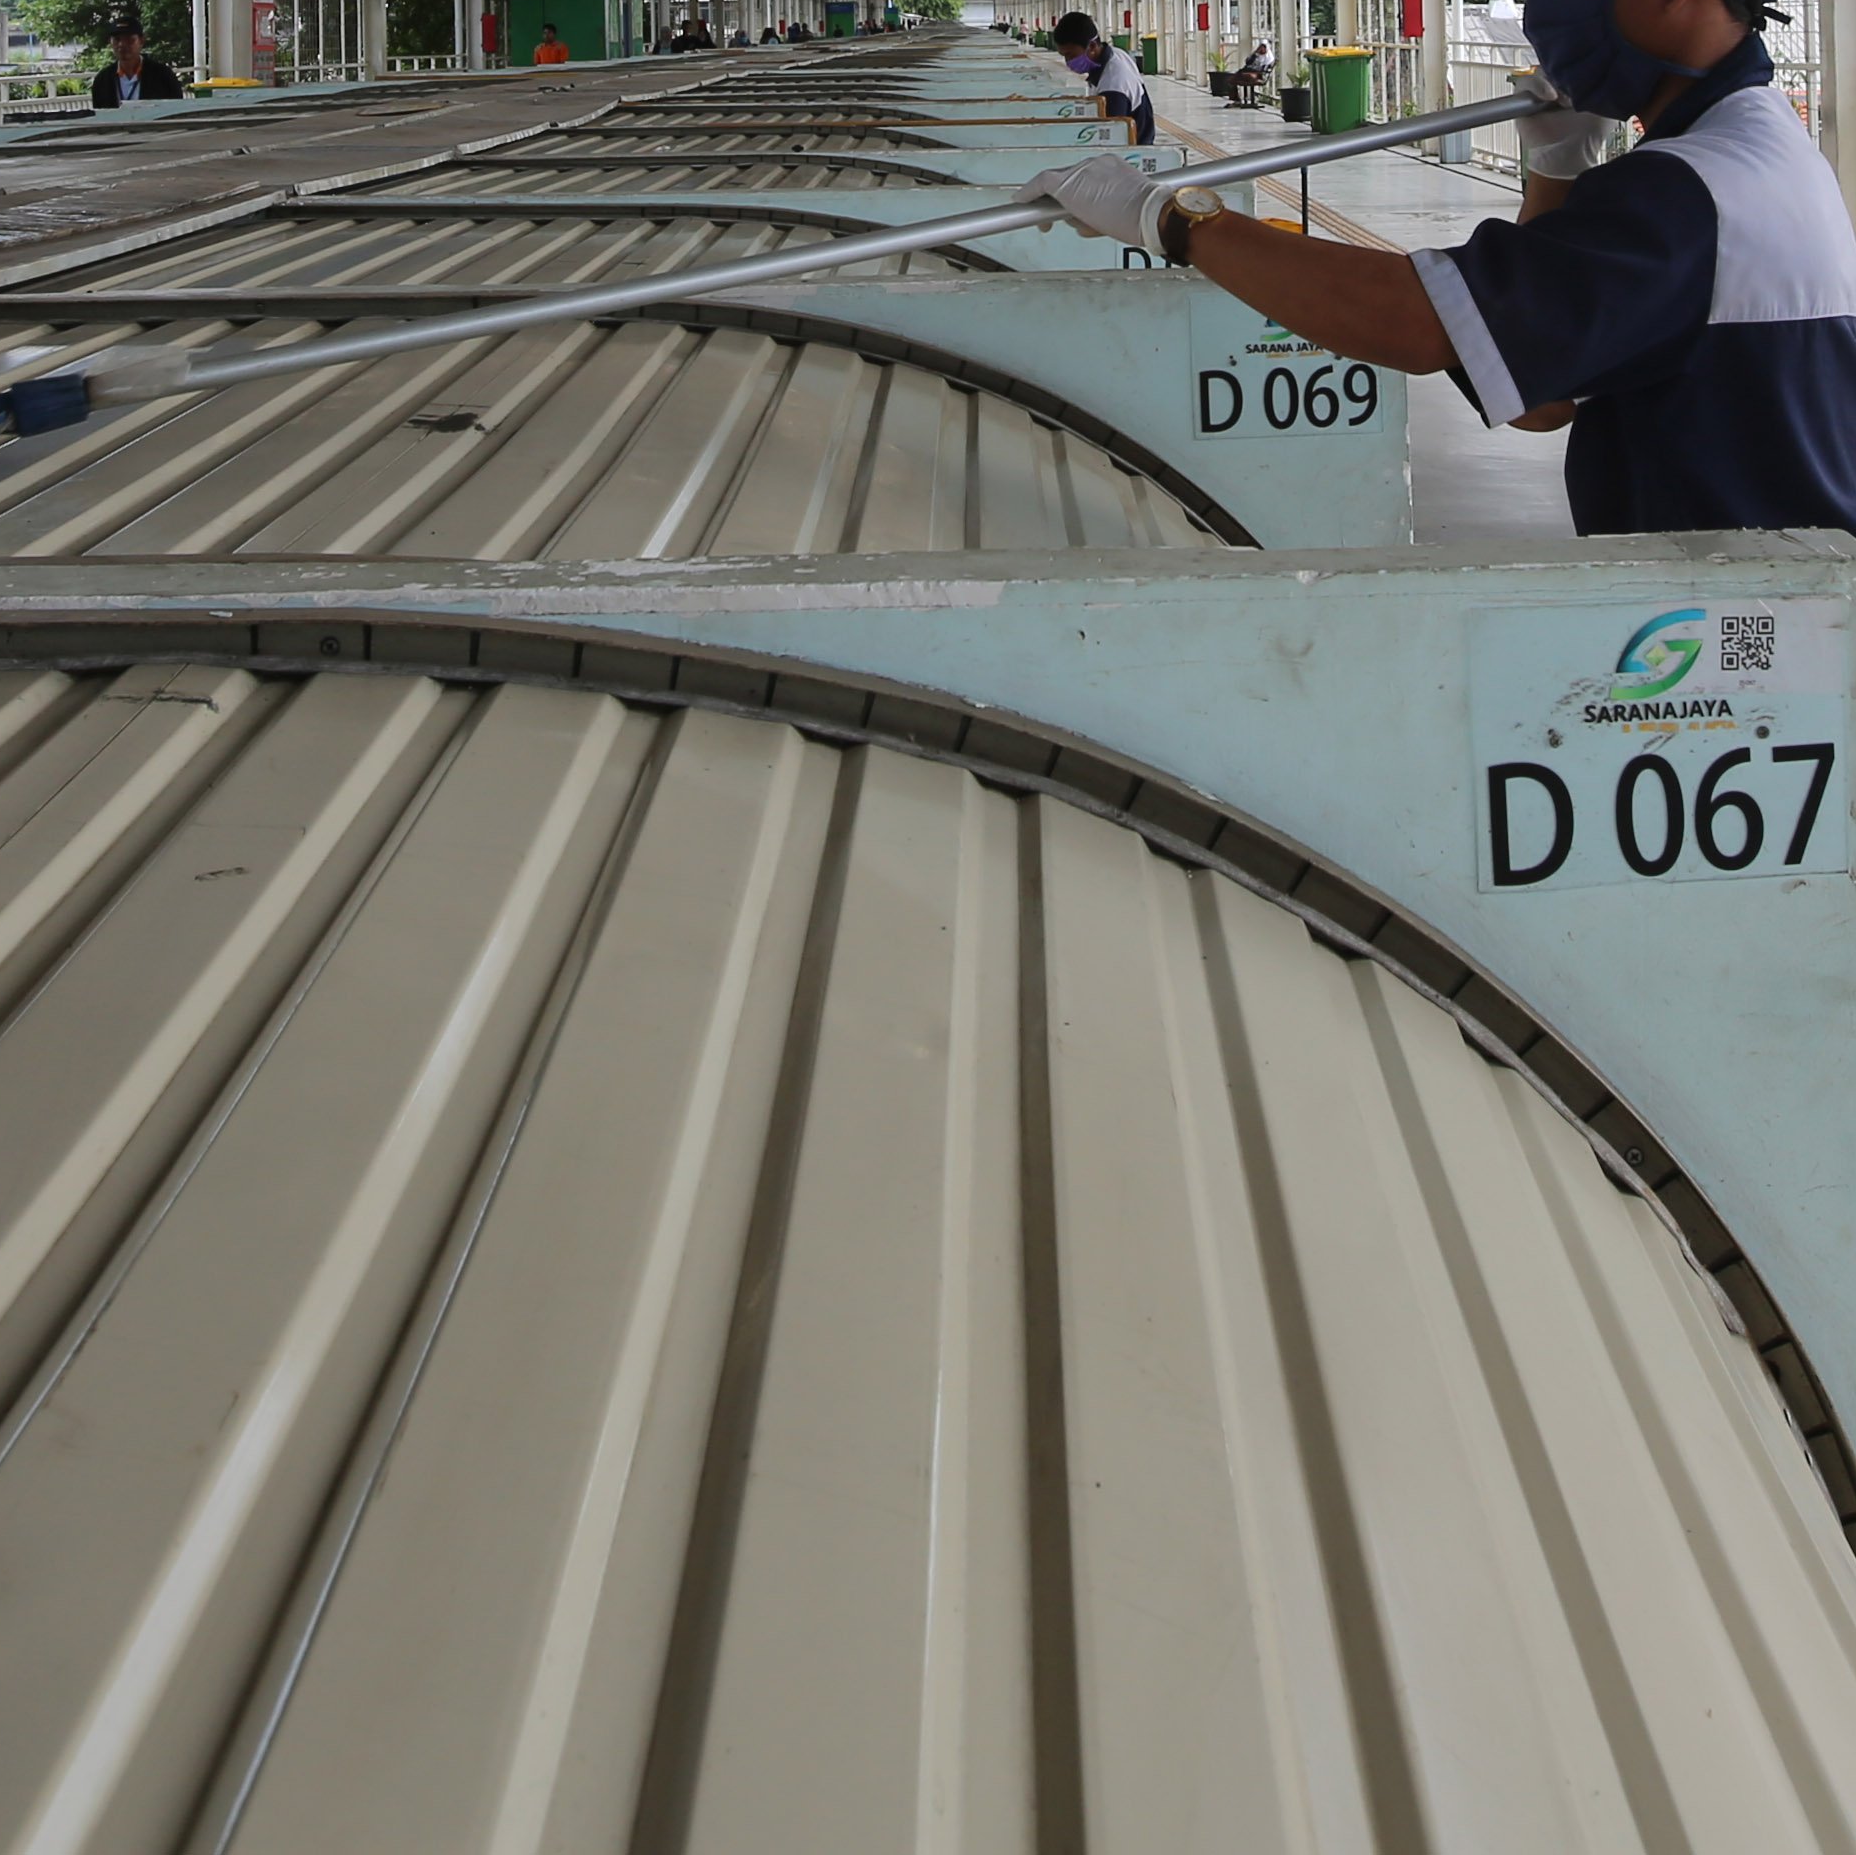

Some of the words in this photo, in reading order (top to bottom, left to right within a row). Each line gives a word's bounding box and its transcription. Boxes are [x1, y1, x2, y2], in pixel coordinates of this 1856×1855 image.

[1245, 343, 1294, 354] SARANA
[1199, 370, 1243, 433] D
[1264, 364, 1378, 429] 069
[1488, 762, 1574, 887] D
[1615, 742, 1835, 877] 067
